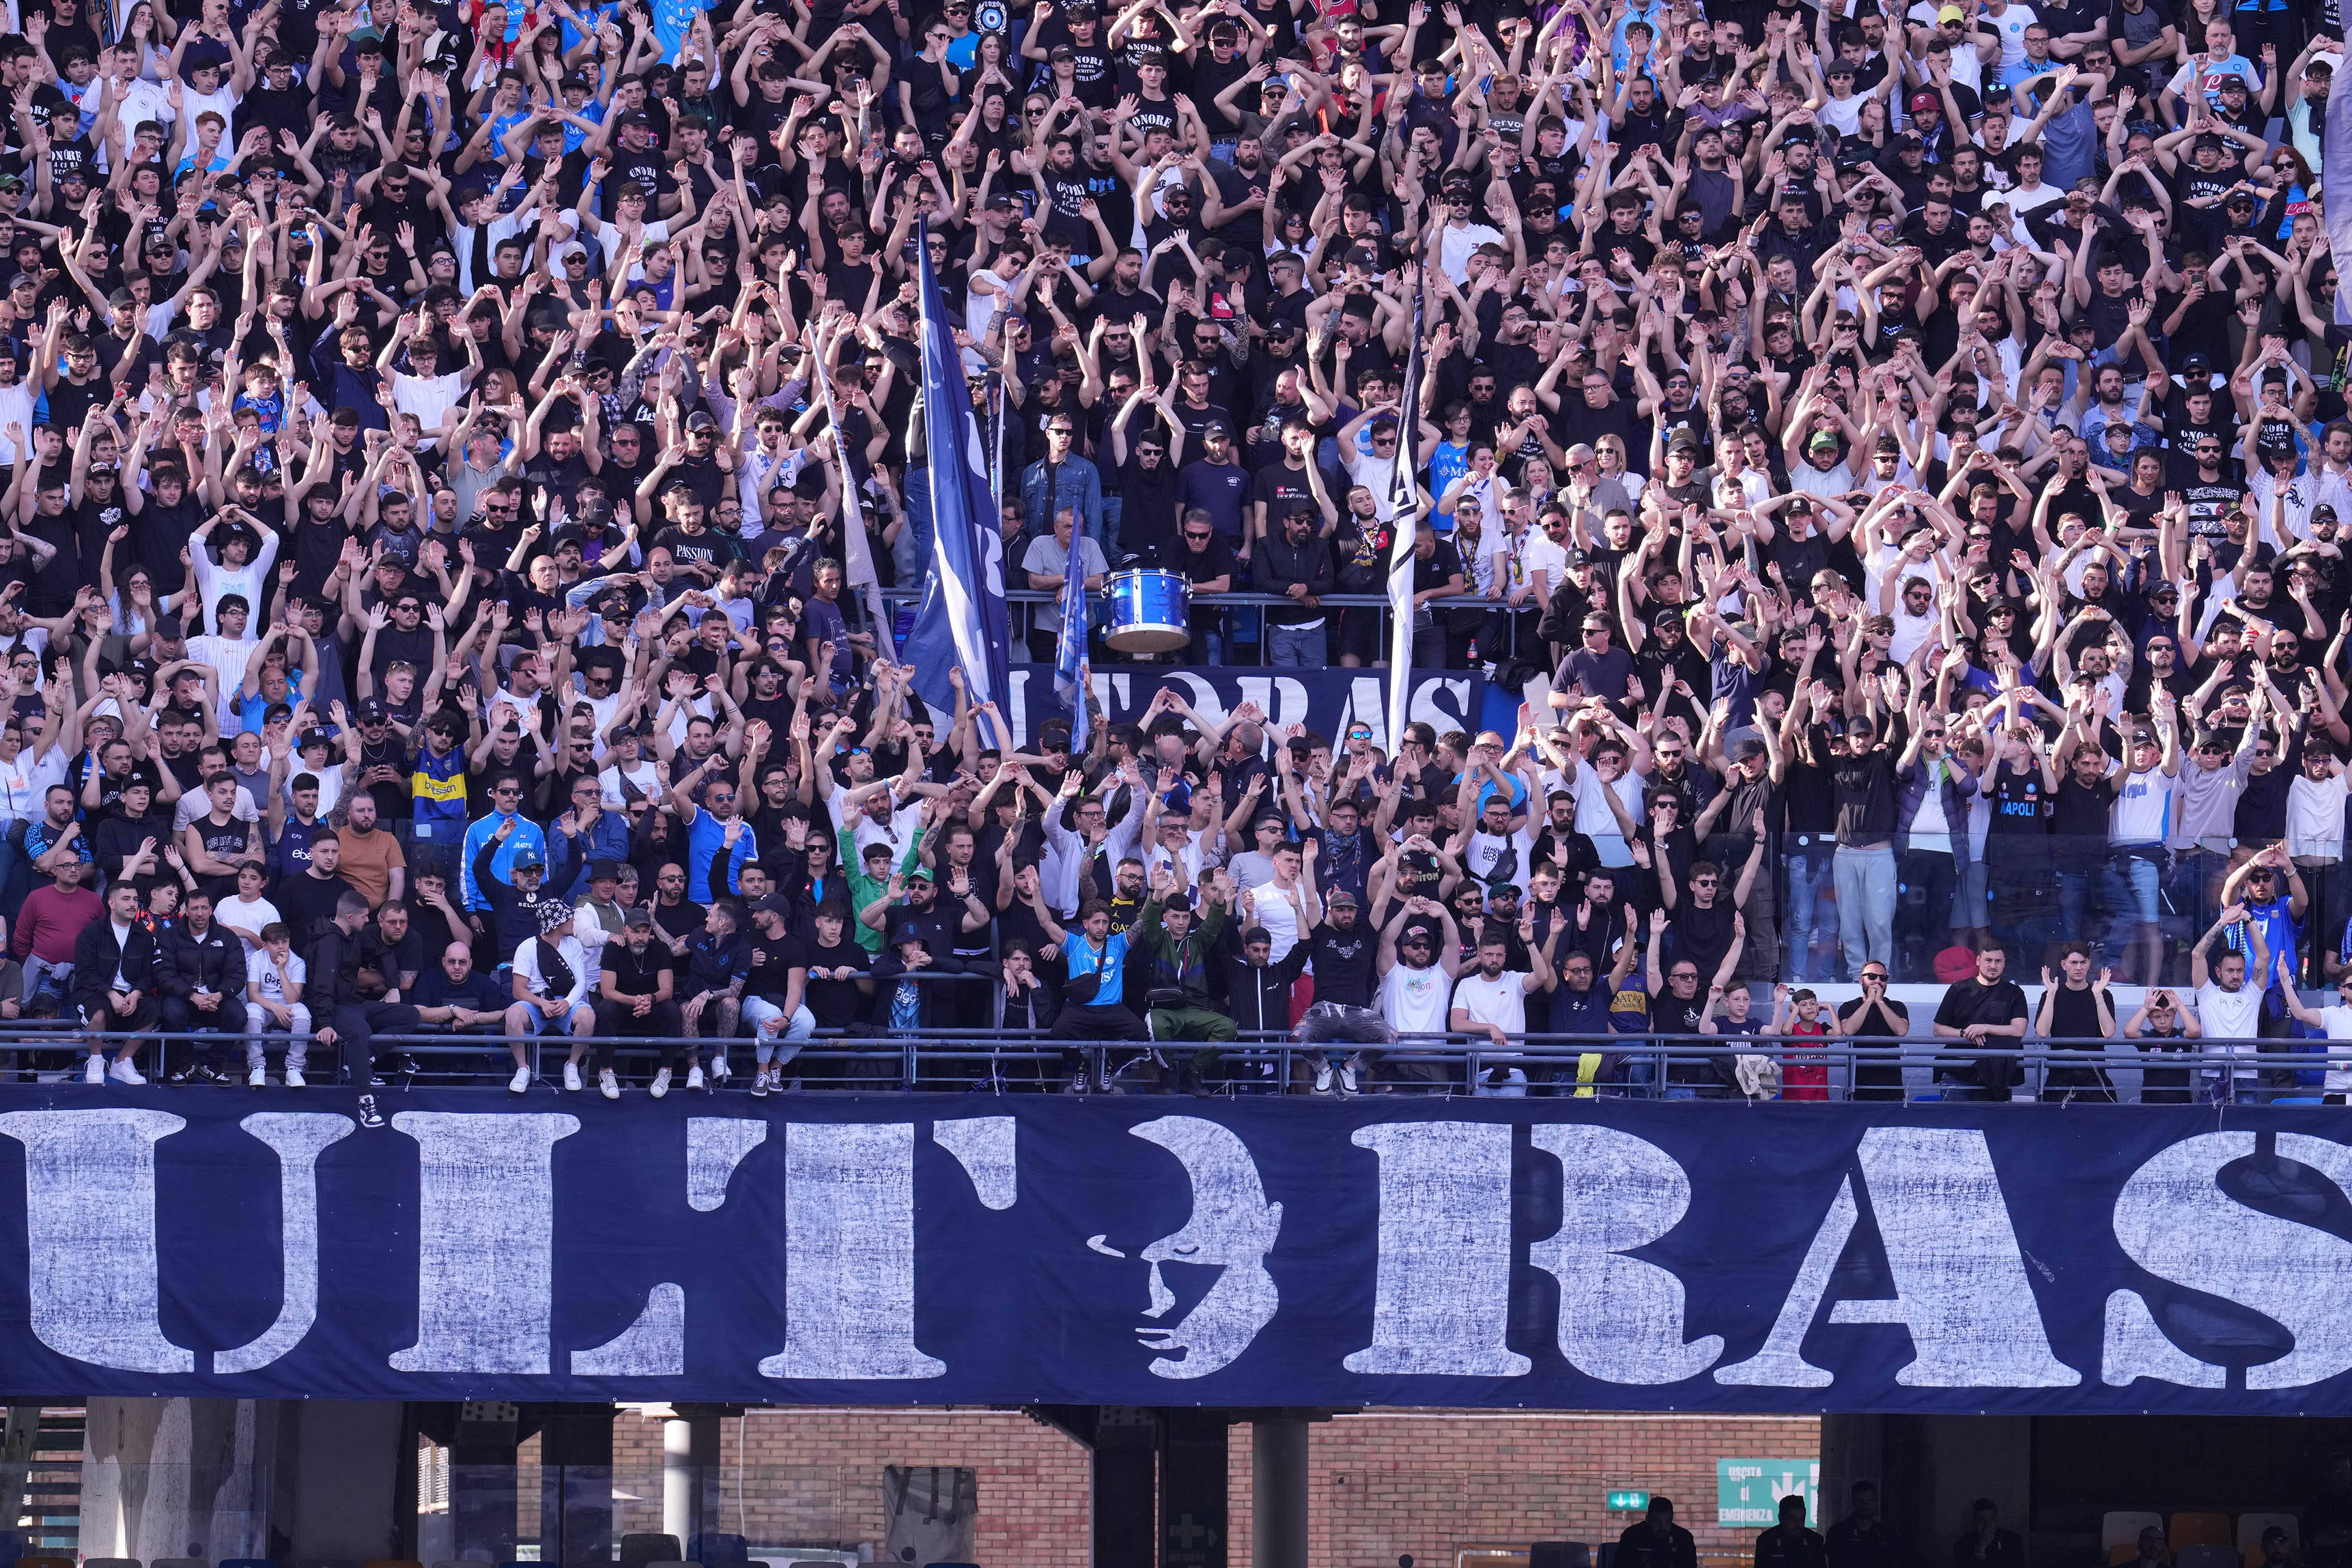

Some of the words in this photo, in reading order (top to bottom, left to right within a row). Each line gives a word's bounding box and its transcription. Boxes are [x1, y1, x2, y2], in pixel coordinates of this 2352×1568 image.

[1075, 56, 1103, 66] NORE
[1132, 114, 1172, 128] ONORE
[2263, 424, 2289, 433] NORE
[2279, 442, 2286, 450] NY
[1450, 466, 1469, 477] MS
[676, 544, 713, 562] PASSION
[369, 701, 378, 709] NY
[425, 779, 457, 795] btsson
[2000, 802, 2035, 816] NAPOLI
[207, 838, 218, 852] LOS
[219, 836, 243, 847] ANES
[292, 848, 313, 861] eba
[1111, 922, 1130, 933] QAT
[697, 943, 709, 951] EA7
[1727, 1466, 1762, 1481] USCITA
